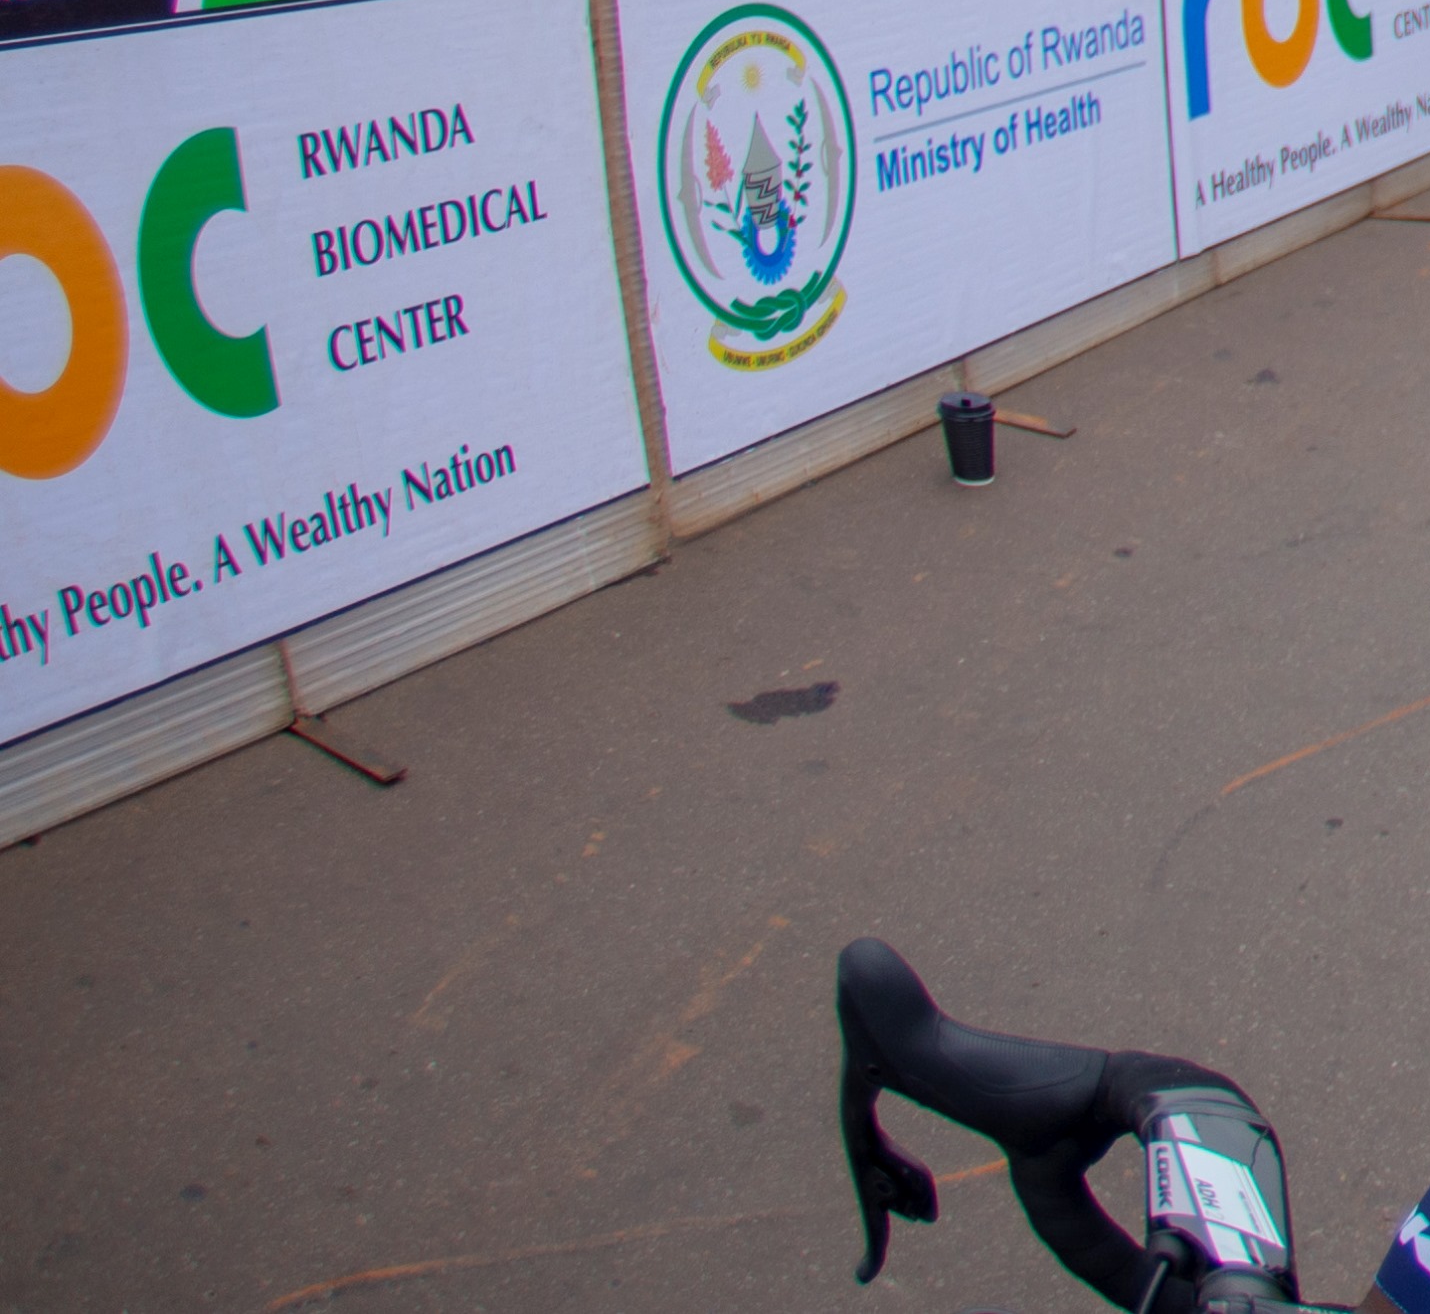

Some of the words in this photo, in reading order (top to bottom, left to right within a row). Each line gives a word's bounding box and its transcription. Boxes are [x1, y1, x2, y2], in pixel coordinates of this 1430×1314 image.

[868, 40, 1002, 118] Republic
[1008, 31, 1035, 77] of
[1041, 8, 1146, 70] Rwanda
[297, 102, 477, 180] RWANDA
[875, 119, 987, 194] Ministry
[992, 110, 1020, 157] of
[1024, 90, 1103, 147] Health
[1194, 180, 1208, 210] A
[1211, 153, 1276, 202] Healthy
[1280, 130, 1338, 177] People.
[1340, 119, 1352, 149] A
[1355, 98, 1413, 142] Wealthy
[311, 179, 549, 279] BIOMEDICAL
[328, 292, 471, 374] CENTER
[57, 550, 204, 638] People.
[213, 532, 243, 584] A
[242, 481, 394, 568] Wealthy
[401, 442, 518, 512] Nation
[1156, 1146, 1172, 1209] LOOK
[1194, 1176, 1220, 1212] ADH
